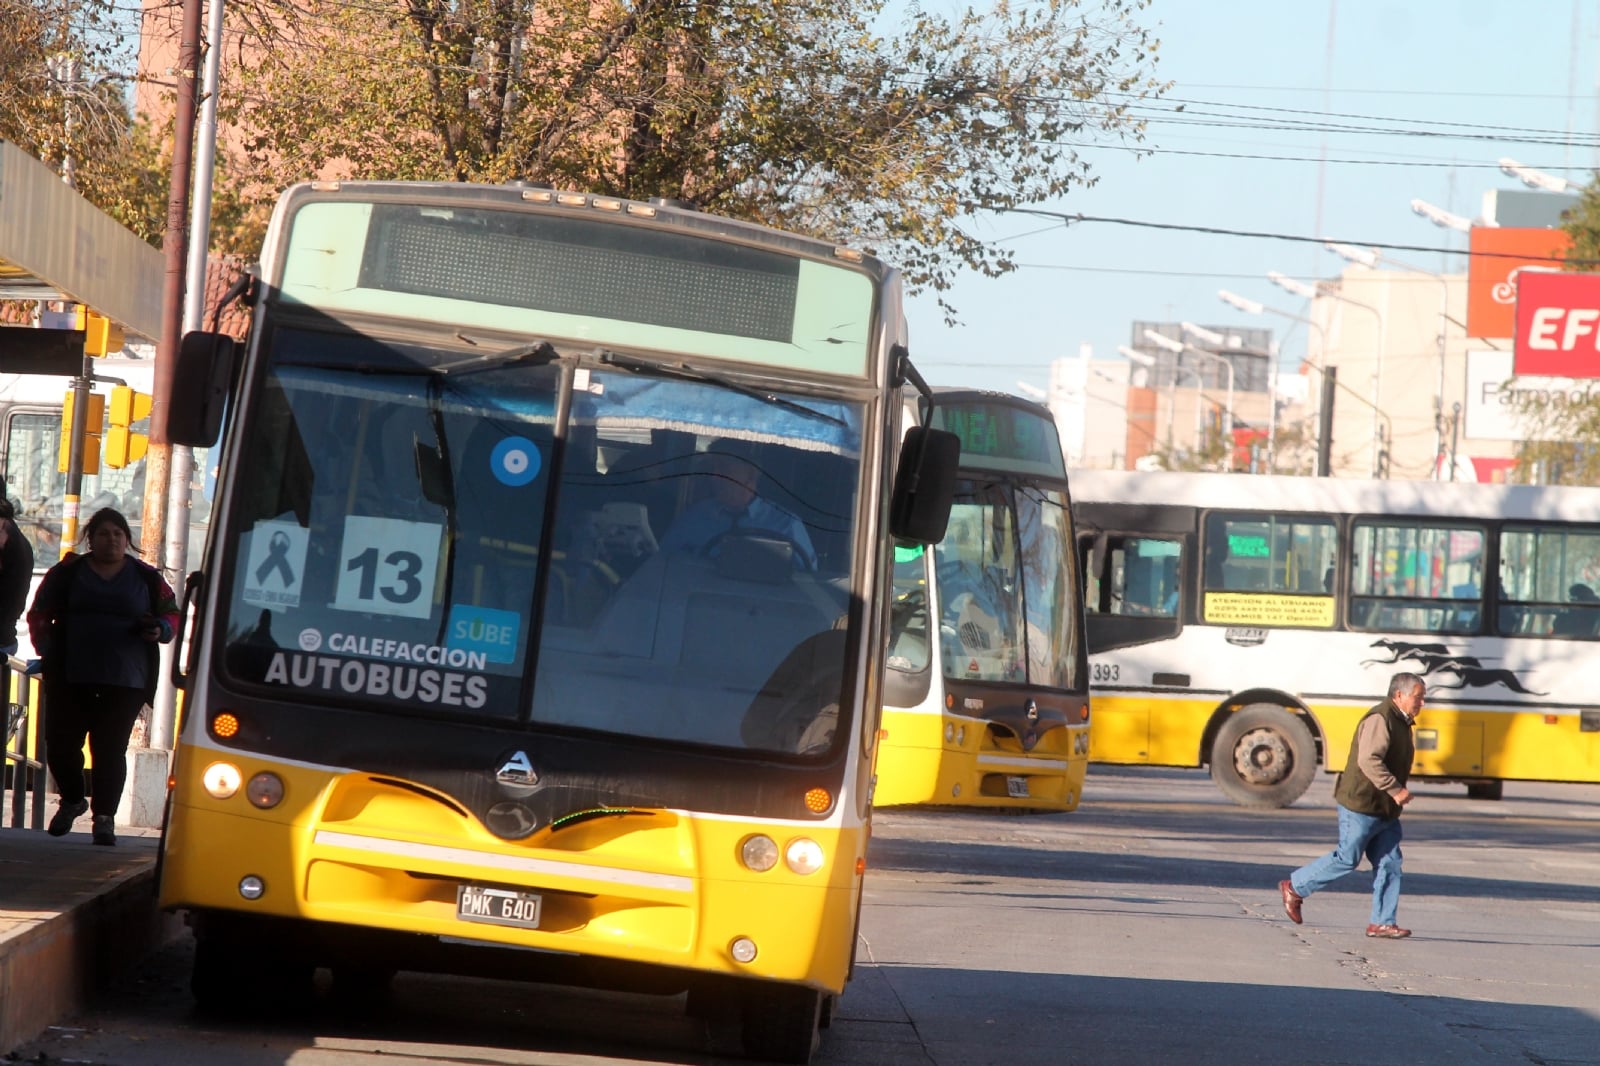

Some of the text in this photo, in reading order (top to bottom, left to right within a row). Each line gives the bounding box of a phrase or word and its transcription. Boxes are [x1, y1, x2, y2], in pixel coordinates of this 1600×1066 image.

[1528, 307, 1600, 352] EF
[347, 547, 423, 604] 13
[455, 616, 513, 646] SUBE
[328, 633, 487, 671] CALEFACCION
[264, 652, 488, 709] AUTOBUSES
[461, 893, 535, 921] PMK 640
